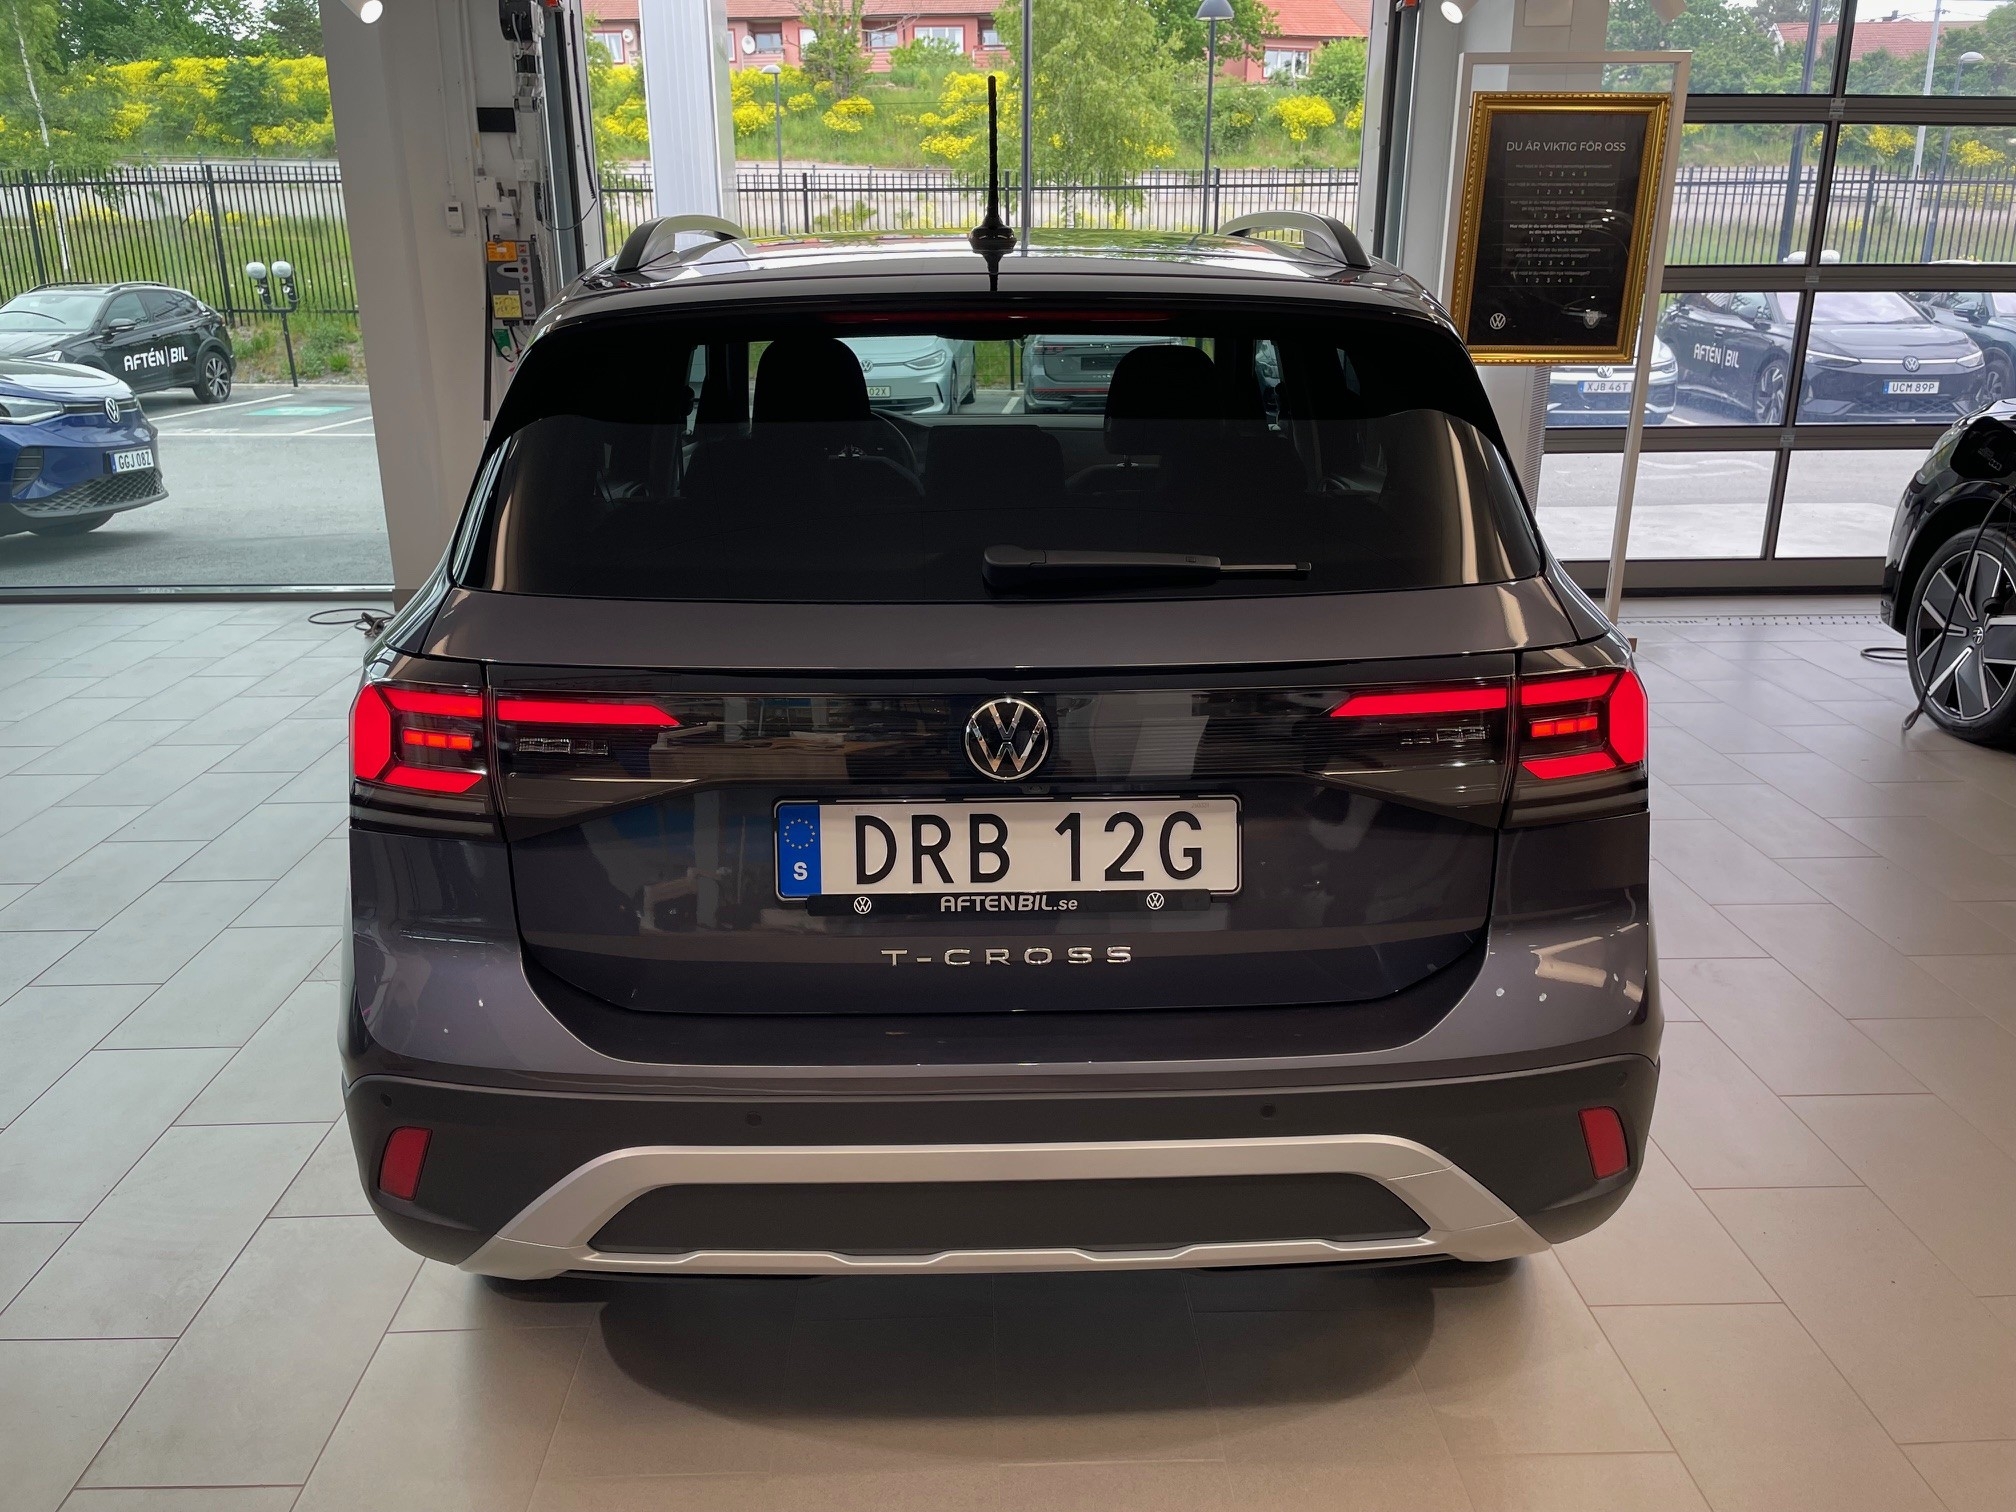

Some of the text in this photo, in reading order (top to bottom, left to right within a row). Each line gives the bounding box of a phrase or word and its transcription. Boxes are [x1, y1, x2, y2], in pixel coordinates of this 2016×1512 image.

[1506, 141, 1523, 152] DU
[1543, 141, 1578, 152] VIKTIG
[1604, 141, 1627, 152] OSS
[123, 346, 189, 372] AFTÉN BIL
[1693, 342, 1740, 368] AFTÉN BIL
[1587, 382, 1628, 392] XJB 46T
[1892, 382, 1935, 393] UCM 89P
[118, 451, 152, 470] GGJ 08Z
[855, 810, 1203, 885] DRB 12G
[792, 860, 808, 882] S
[940, 894, 1080, 912] AFTENBIL.se
[880, 946, 1132, 967] T-CROSS
